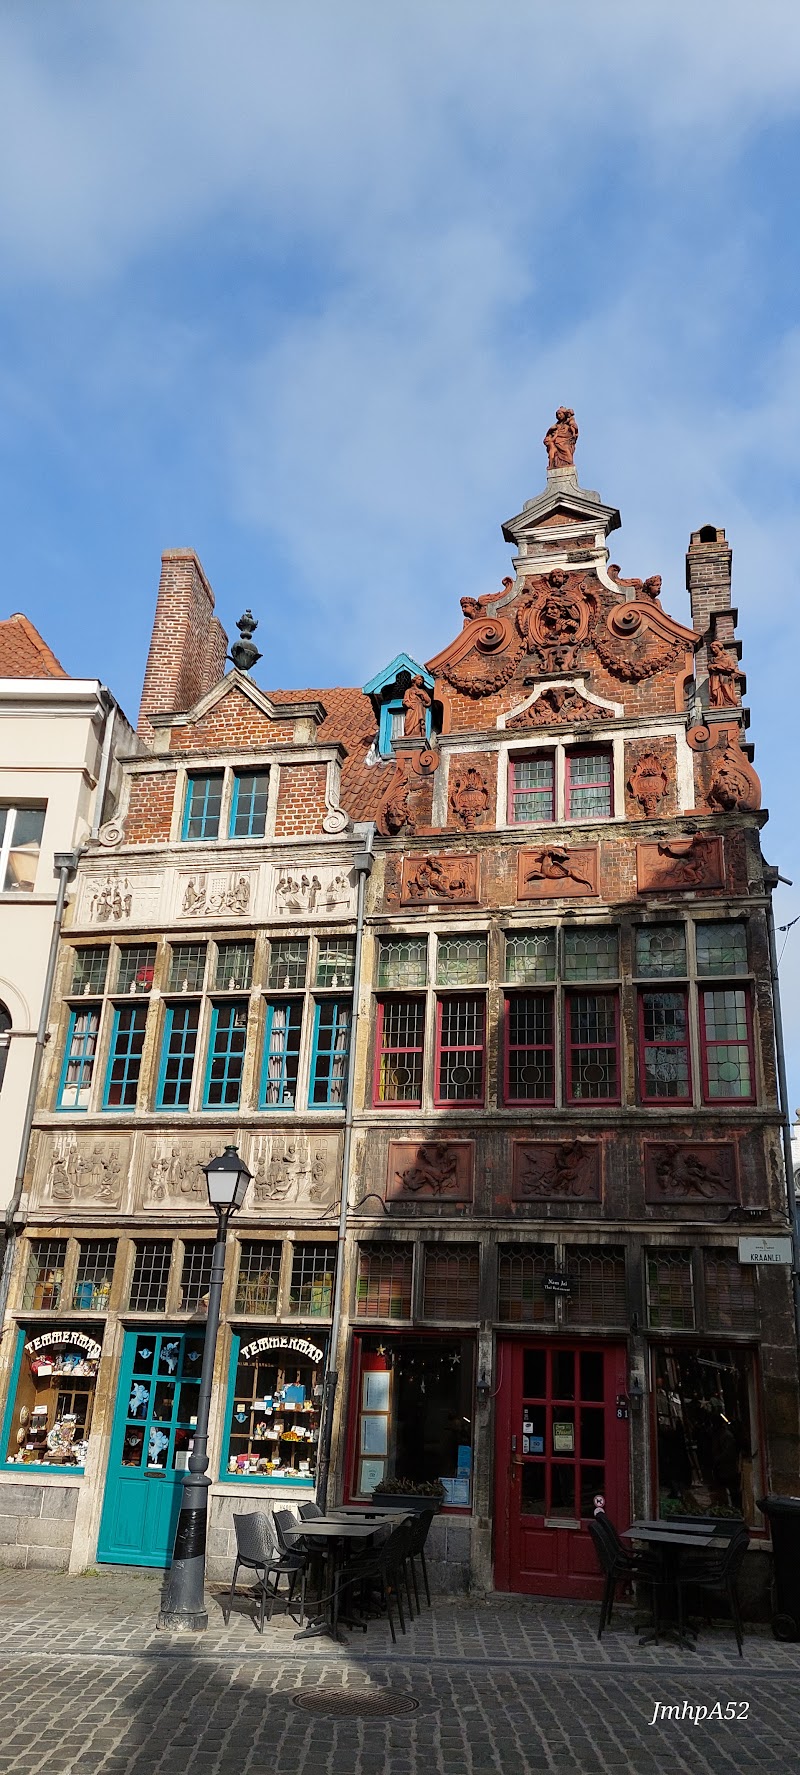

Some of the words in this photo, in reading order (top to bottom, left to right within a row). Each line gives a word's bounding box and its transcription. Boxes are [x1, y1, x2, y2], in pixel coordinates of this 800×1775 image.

[750, 1253, 781, 1262] KRAANLEI
[24, 1331, 102, 1356] TEMMERMAN
[240, 1336, 324, 1364] TEMMERMAN
[617, 1409, 628, 1418] 81
